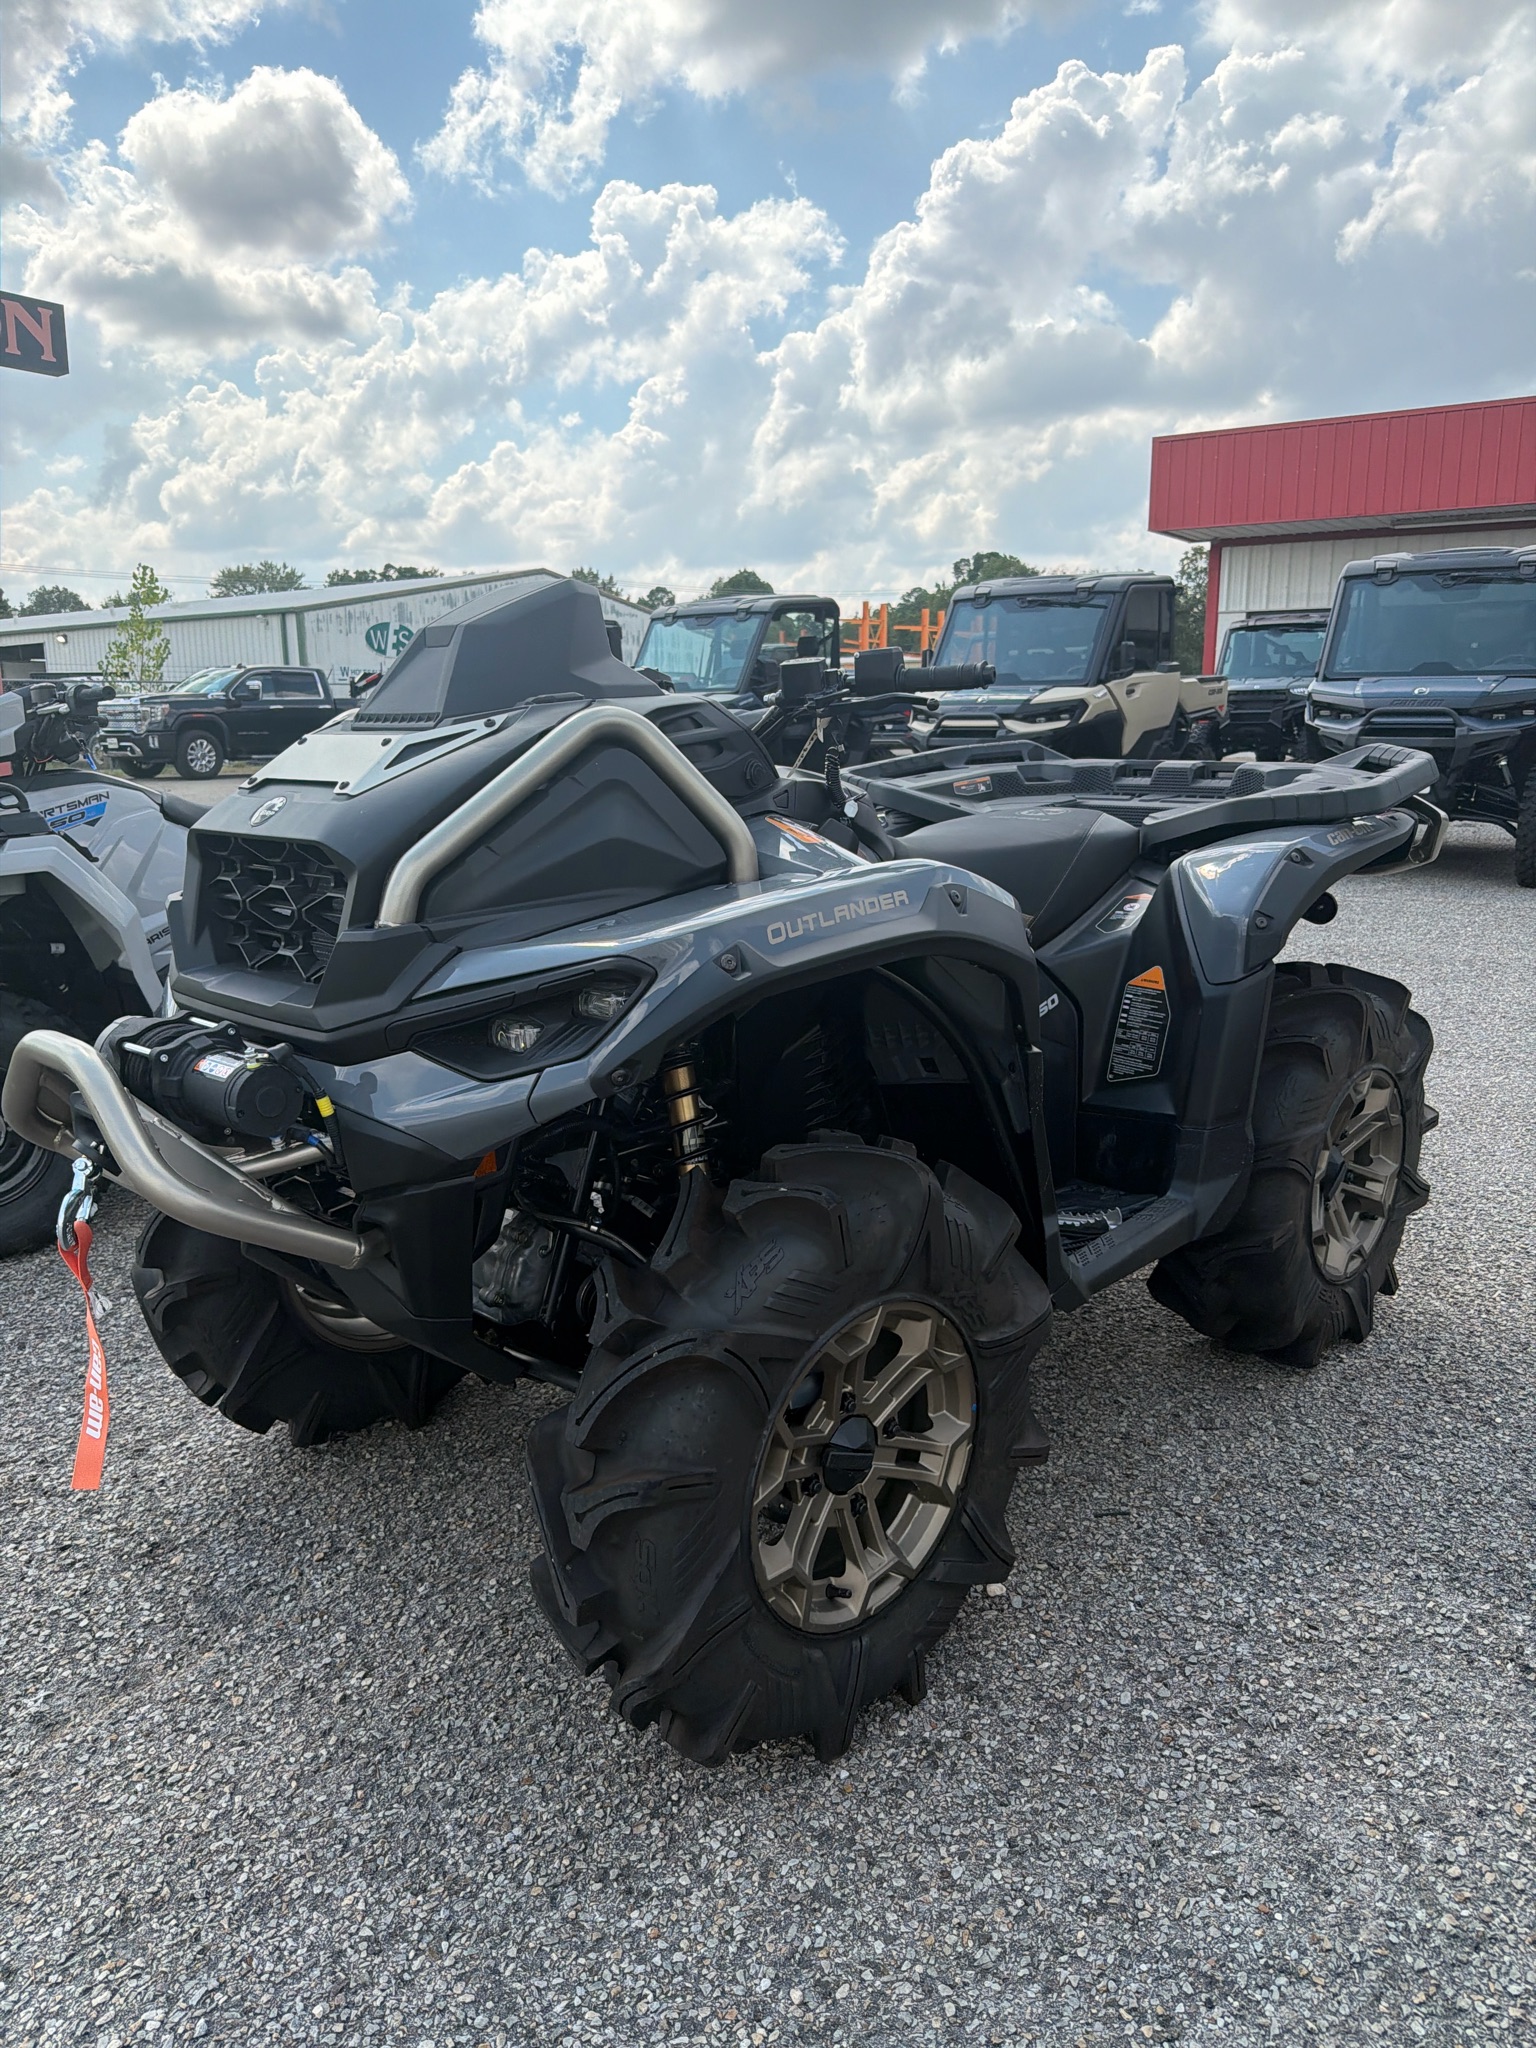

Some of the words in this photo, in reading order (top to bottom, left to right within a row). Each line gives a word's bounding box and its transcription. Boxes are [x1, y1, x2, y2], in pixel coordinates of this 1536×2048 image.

[40, 790, 111, 818] RTSMAN
[766, 889, 910, 945] OUTLANDER
[86, 1338, 103, 1440] can-am
